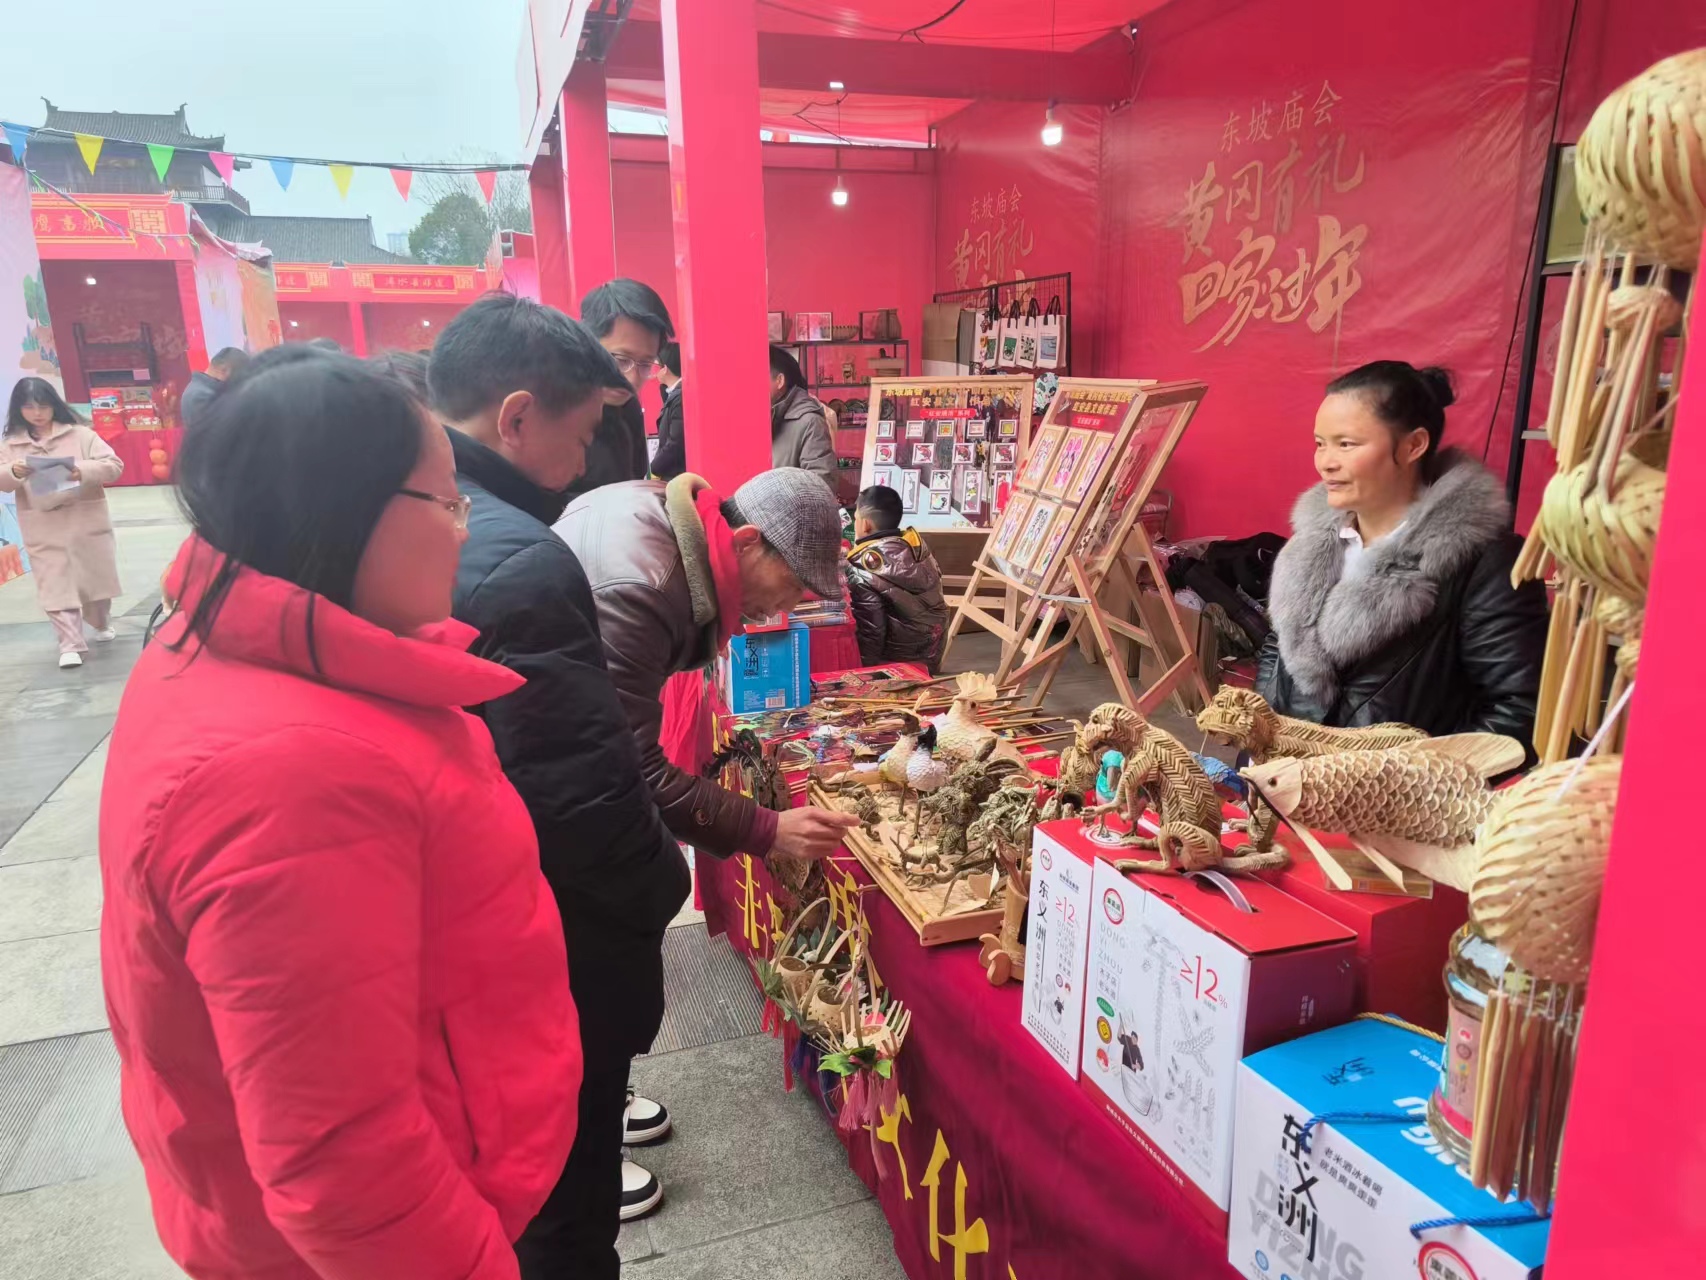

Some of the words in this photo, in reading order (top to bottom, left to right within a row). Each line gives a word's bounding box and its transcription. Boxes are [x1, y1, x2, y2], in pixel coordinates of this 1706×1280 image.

[1220, 80, 1343, 153] 东坡庙会
[969, 183, 1023, 225] 东坡庙会
[1166, 132, 1367, 265] 黄冈有礼
[1180, 215, 1370, 353] 回家过年
[1036, 879, 1050, 940] 东义洲
